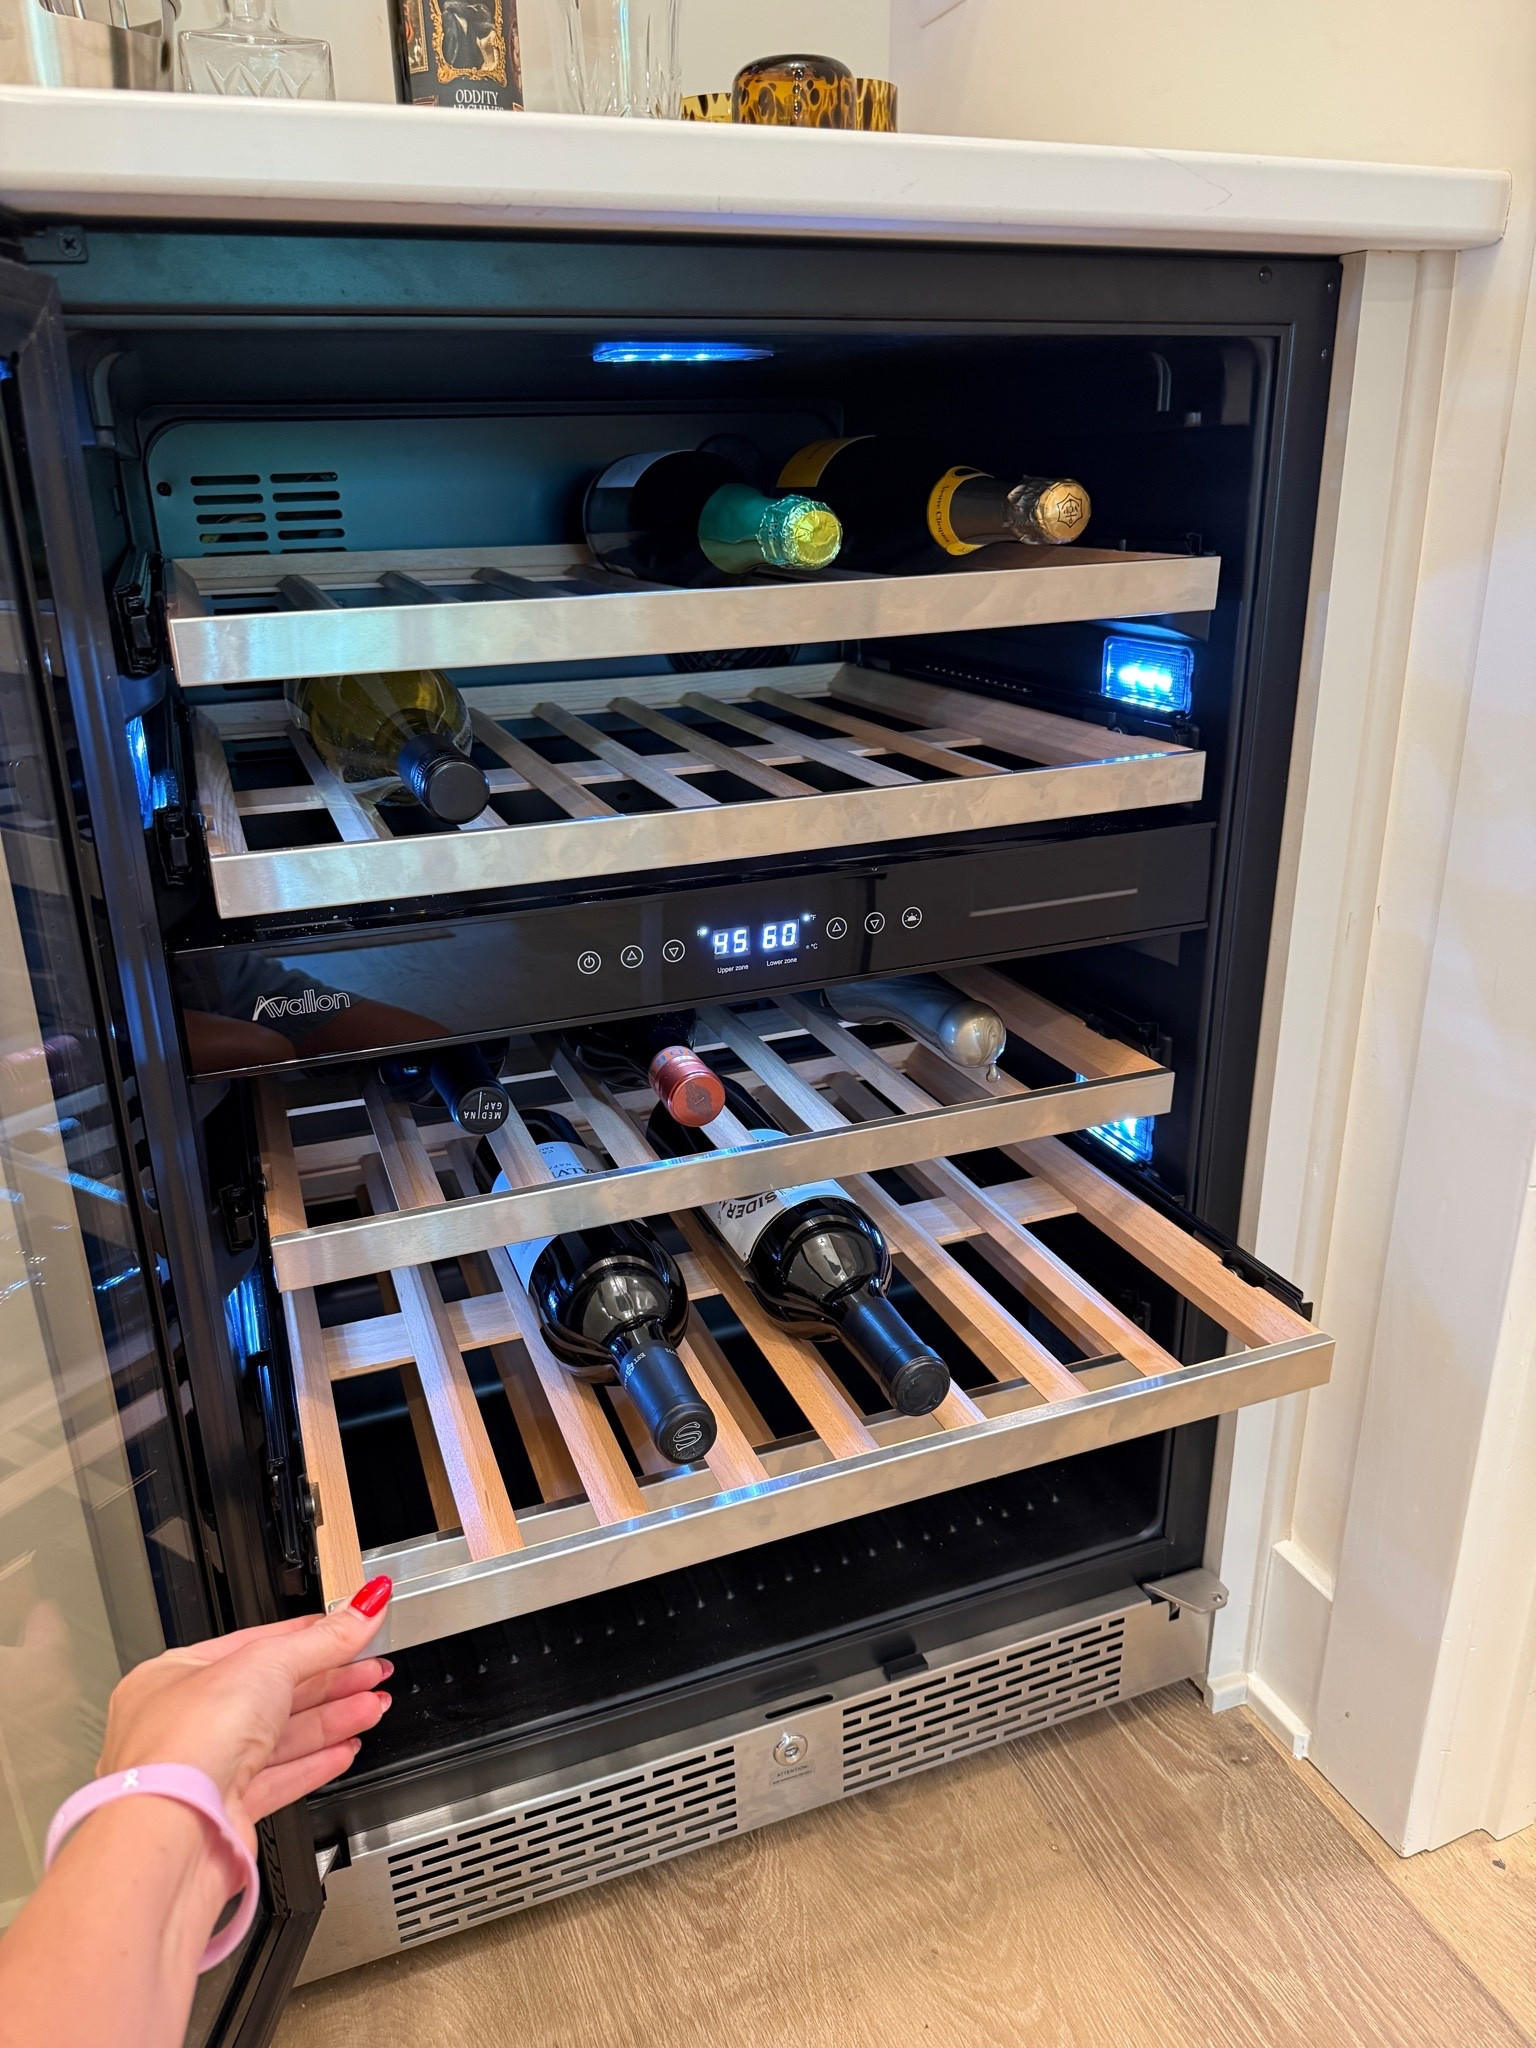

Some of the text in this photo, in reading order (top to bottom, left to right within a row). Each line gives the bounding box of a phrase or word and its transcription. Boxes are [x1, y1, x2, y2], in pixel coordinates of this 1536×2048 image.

[455, 89, 499, 106] ODDITY
[713, 922, 797, 955] 45 60
[766, 959, 784, 967] Lower
[717, 966, 735, 975] Upper
[252, 989, 351, 1021] Avallon
[484, 1101, 502, 1111] GAP
